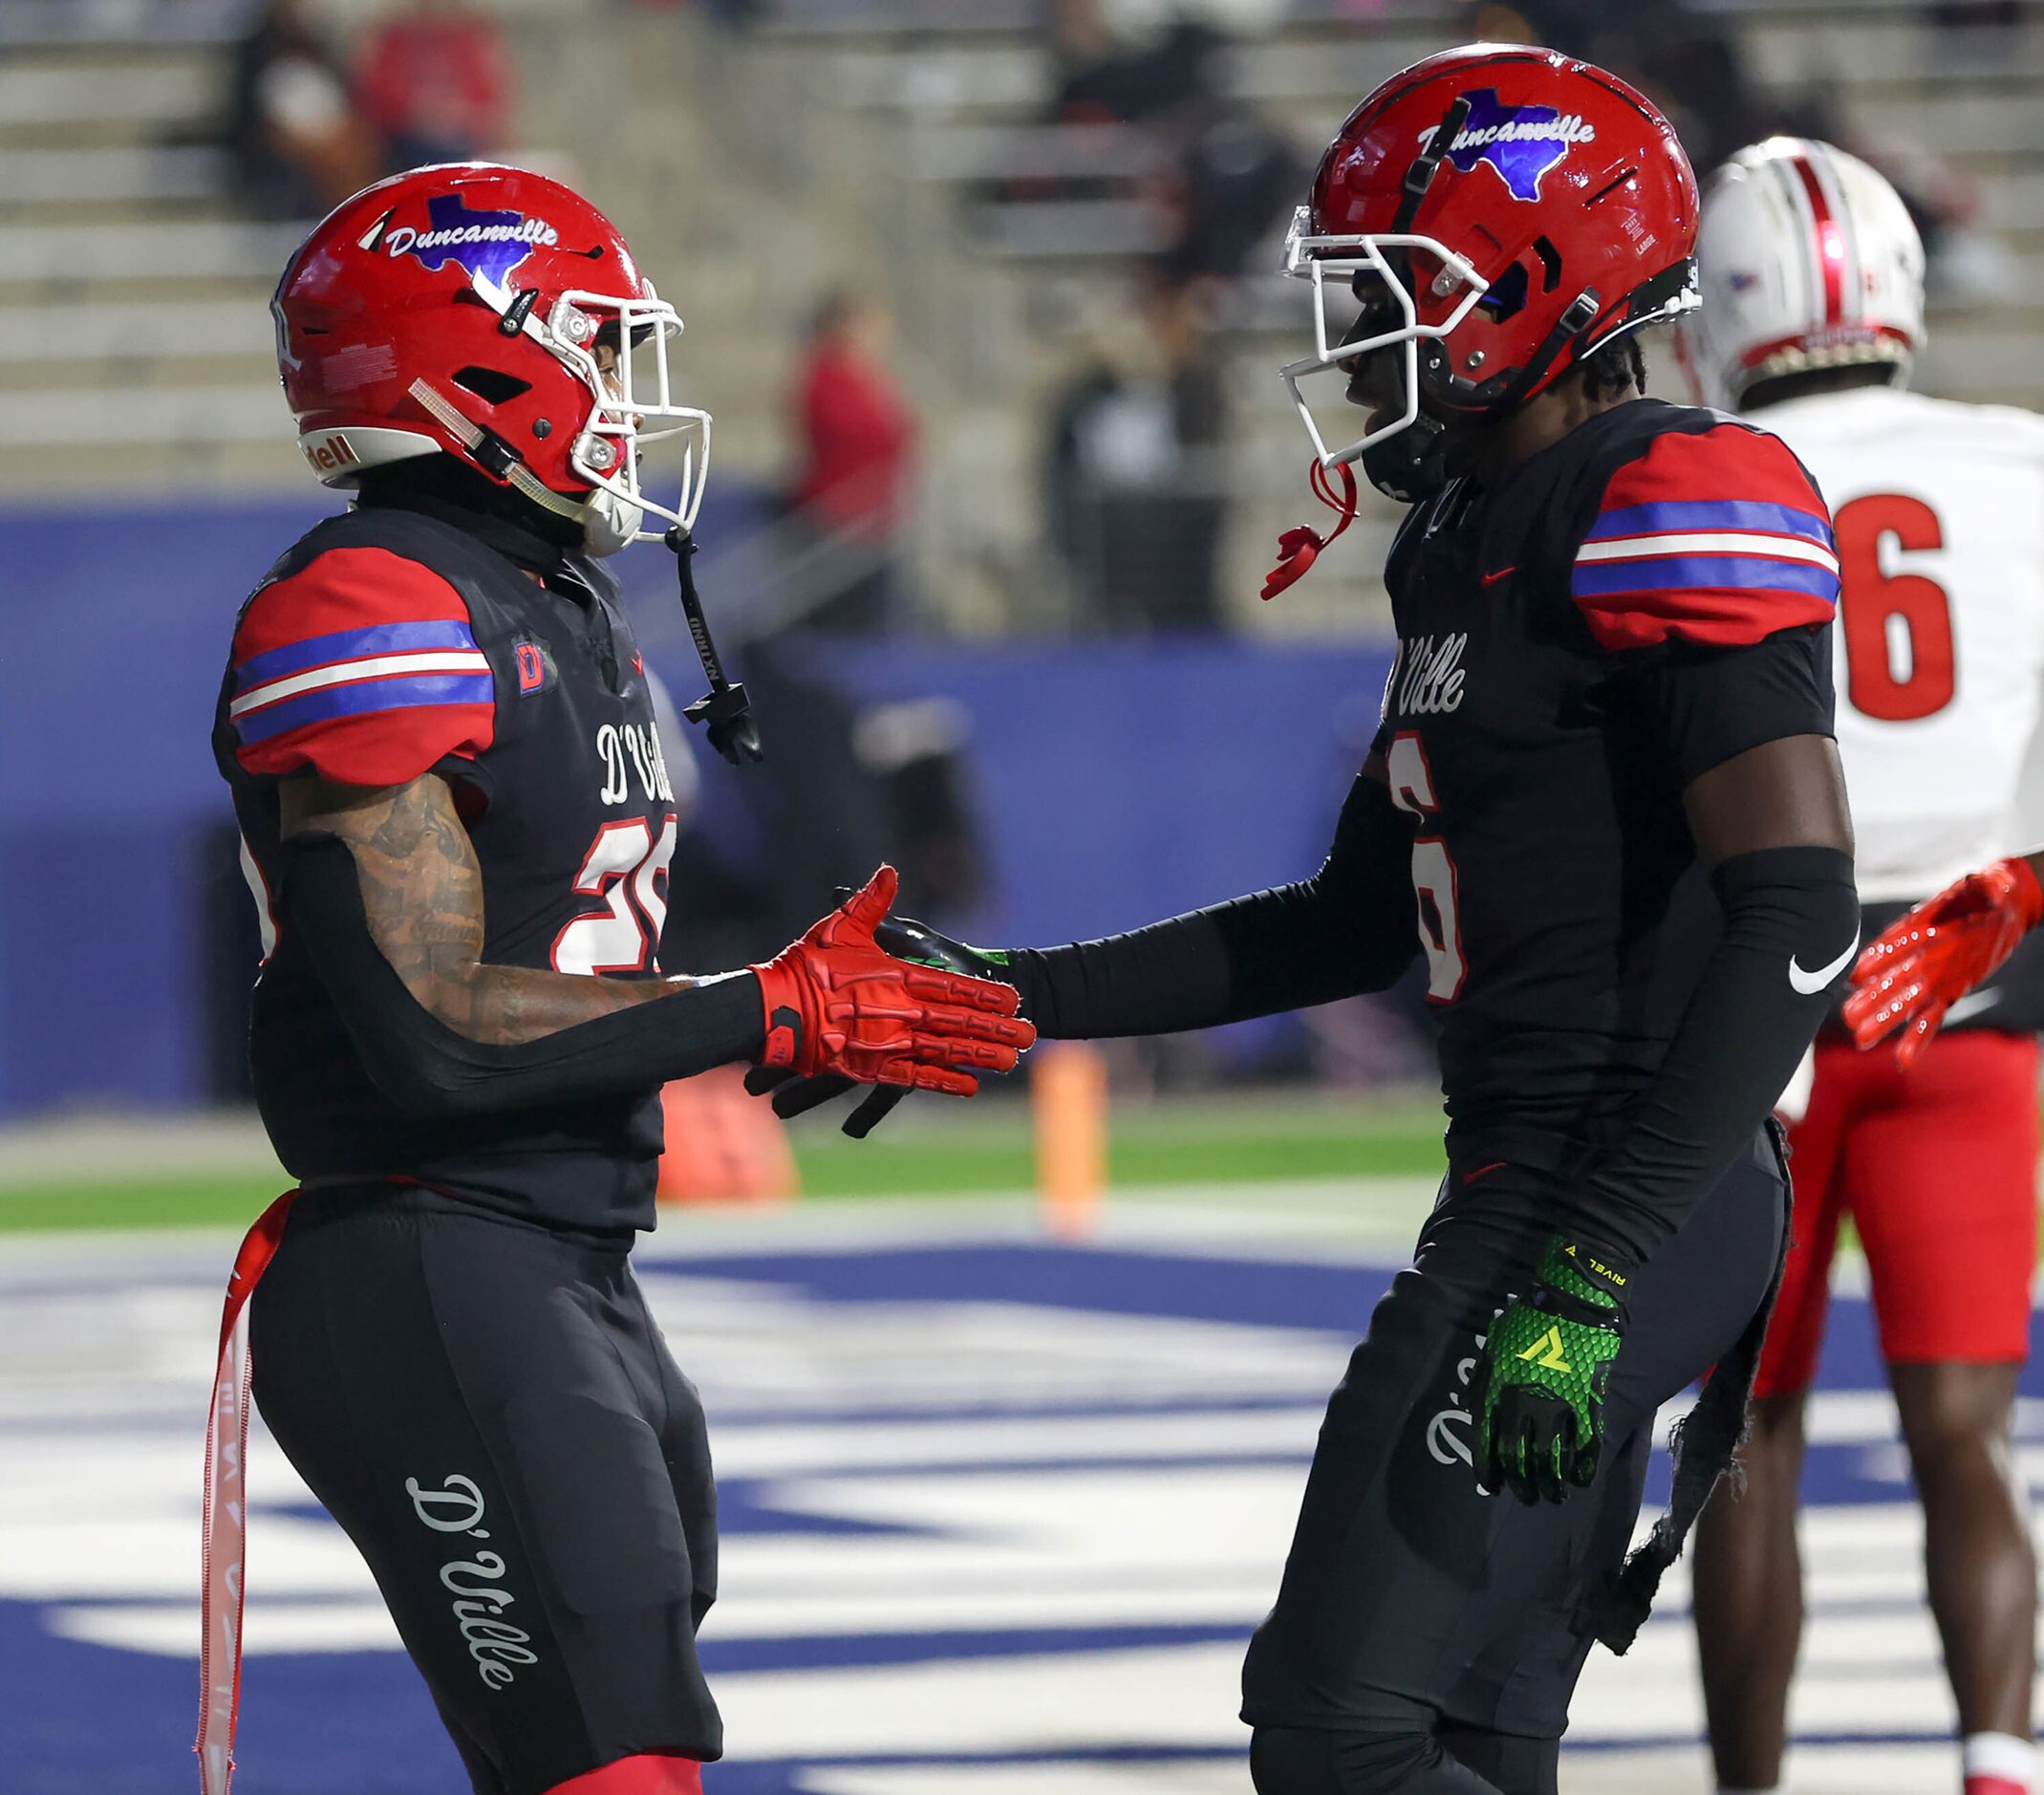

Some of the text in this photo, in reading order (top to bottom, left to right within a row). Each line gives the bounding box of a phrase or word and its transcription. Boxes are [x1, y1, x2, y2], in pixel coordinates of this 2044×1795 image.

[385, 217, 559, 258] Duncanville
[1832, 494, 1955, 722] 6
[514, 641, 545, 696] D
[1589, 1258, 1627, 1287] RIVEL
[405, 1474, 539, 1691] D'Ville
